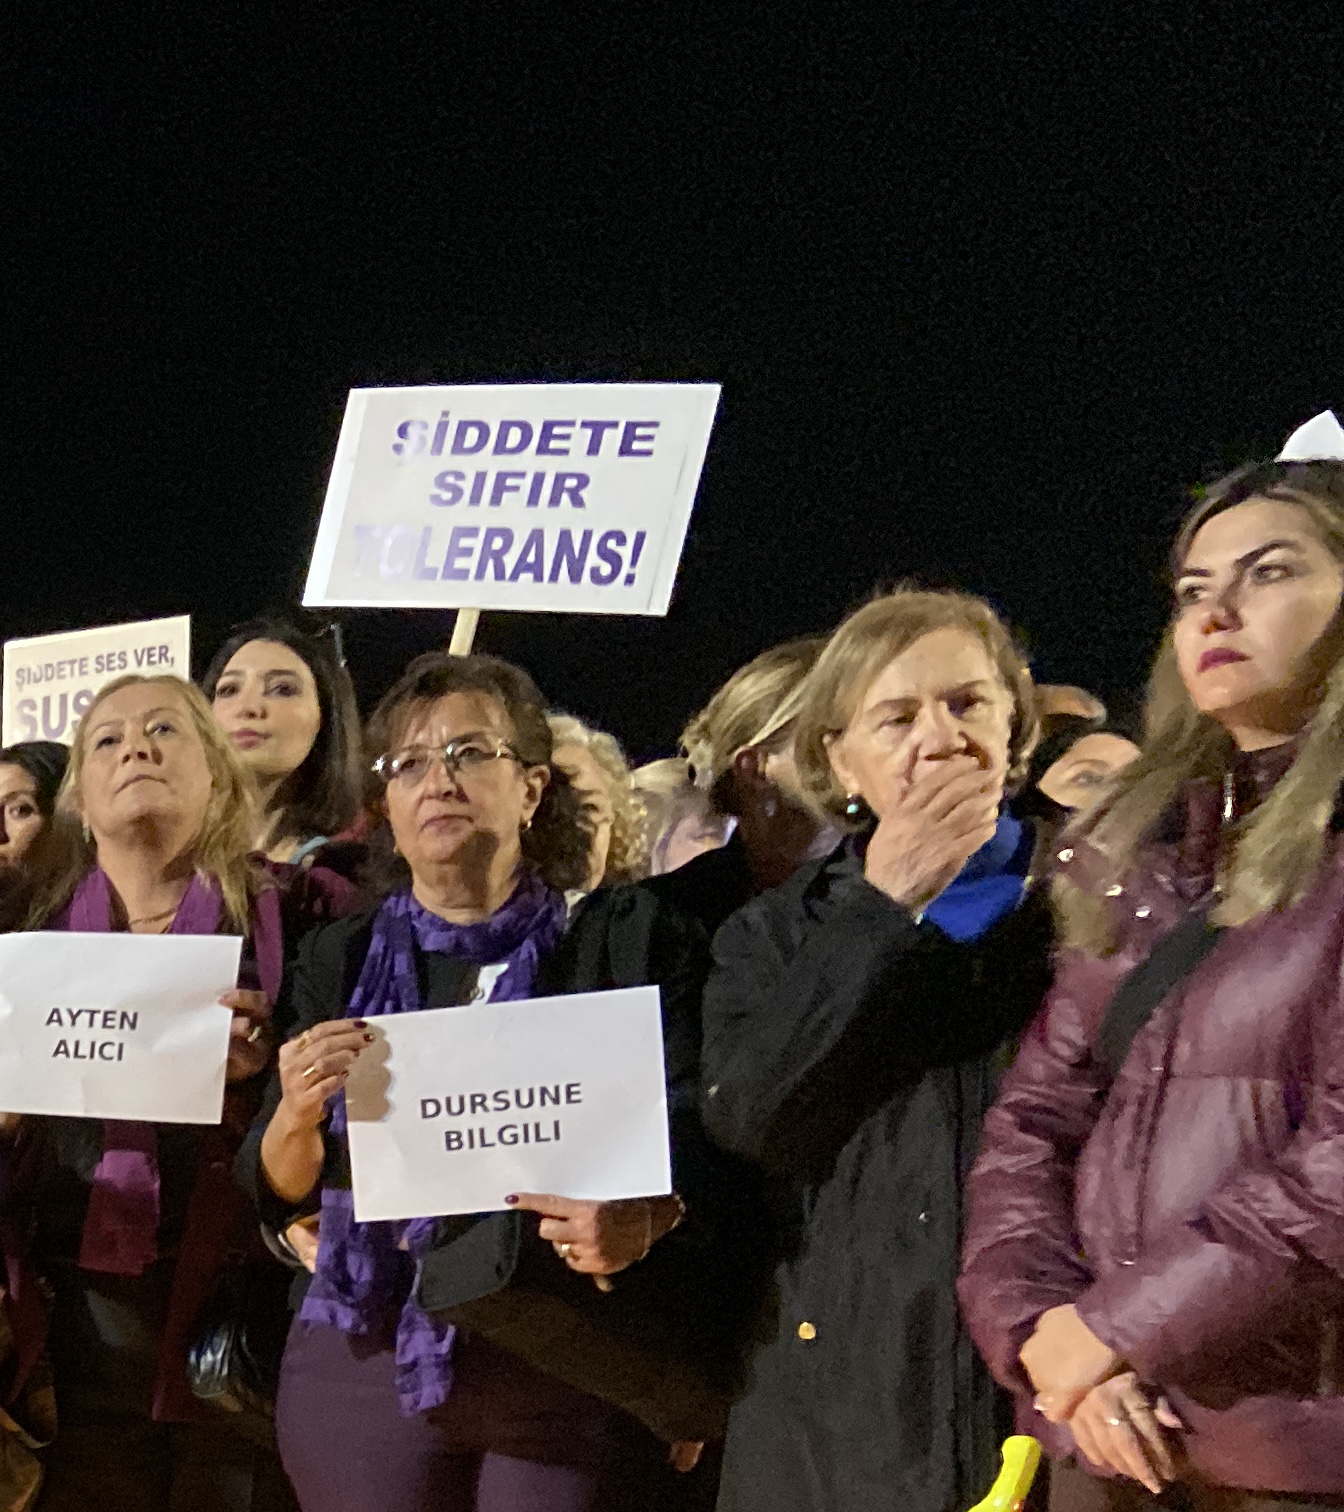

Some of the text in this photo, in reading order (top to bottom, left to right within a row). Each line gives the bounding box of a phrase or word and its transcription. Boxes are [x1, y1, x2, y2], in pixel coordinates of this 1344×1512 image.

[429, 470, 590, 508] SIFIR
[94, 651, 128, 675] SES
[133, 645, 176, 668] VER,
[45, 1006, 139, 1031] AYTEN
[51, 1040, 125, 1062] ALICI
[420, 1082, 584, 1119] DURSUNE
[444, 1119, 562, 1151] BILGILI
